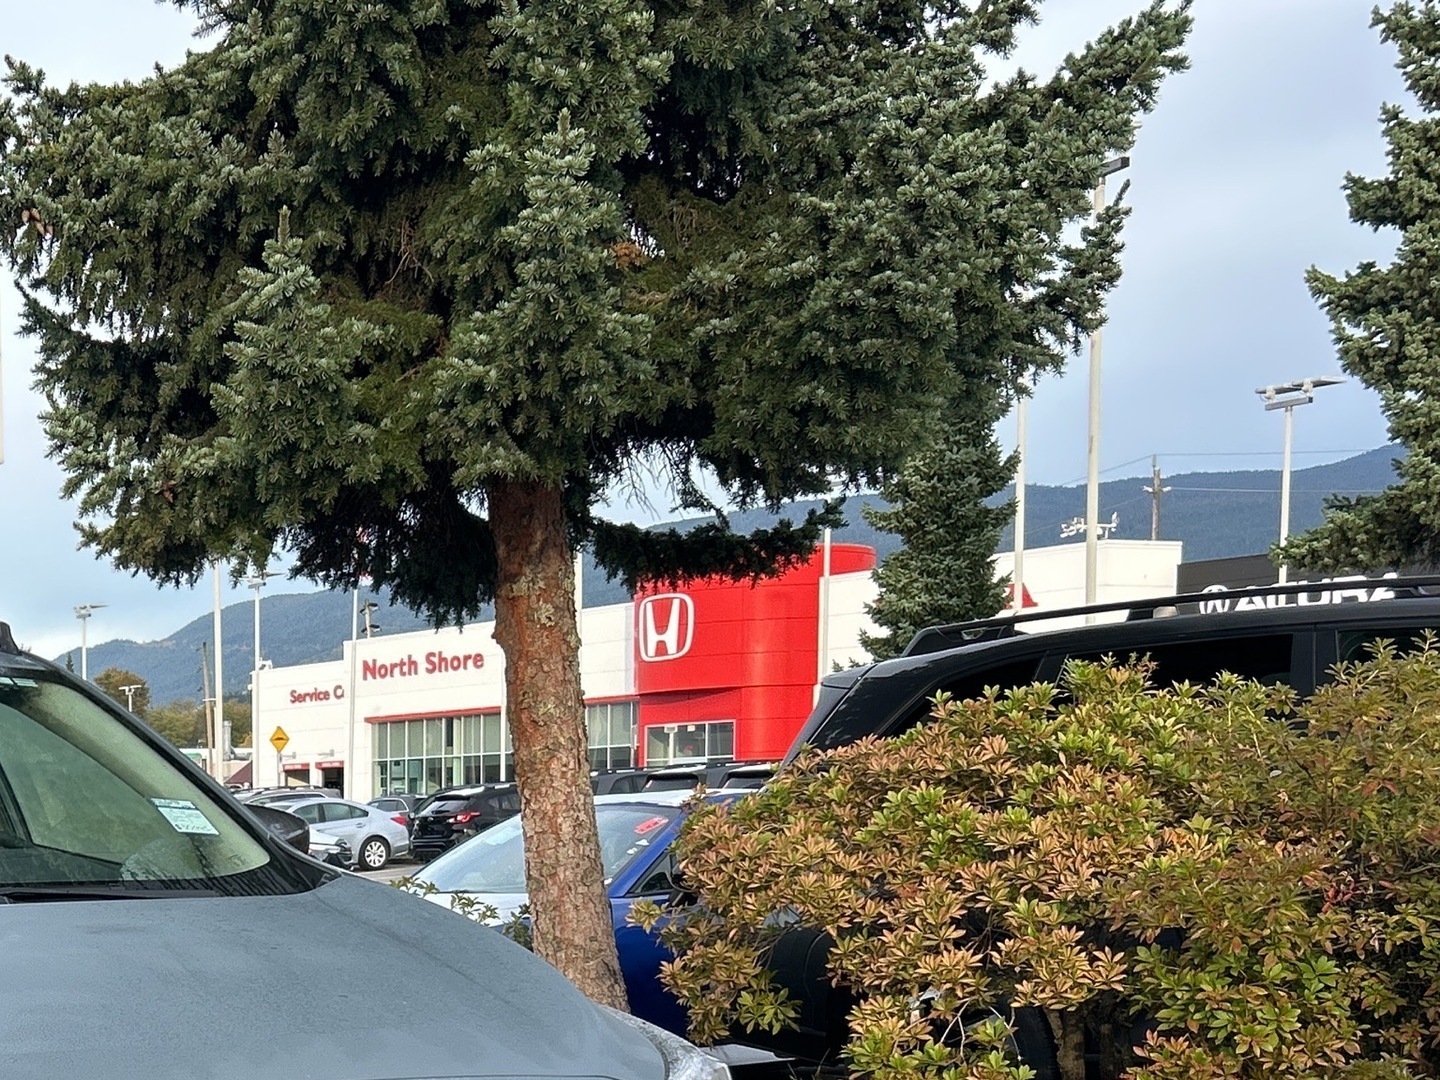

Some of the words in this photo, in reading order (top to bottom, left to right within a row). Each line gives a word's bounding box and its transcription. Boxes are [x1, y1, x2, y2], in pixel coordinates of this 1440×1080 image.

[362, 654, 419, 681] North
[425, 651, 485, 675] Shore
[290, 686, 331, 704] Service
[333, 684, 345, 700] C
